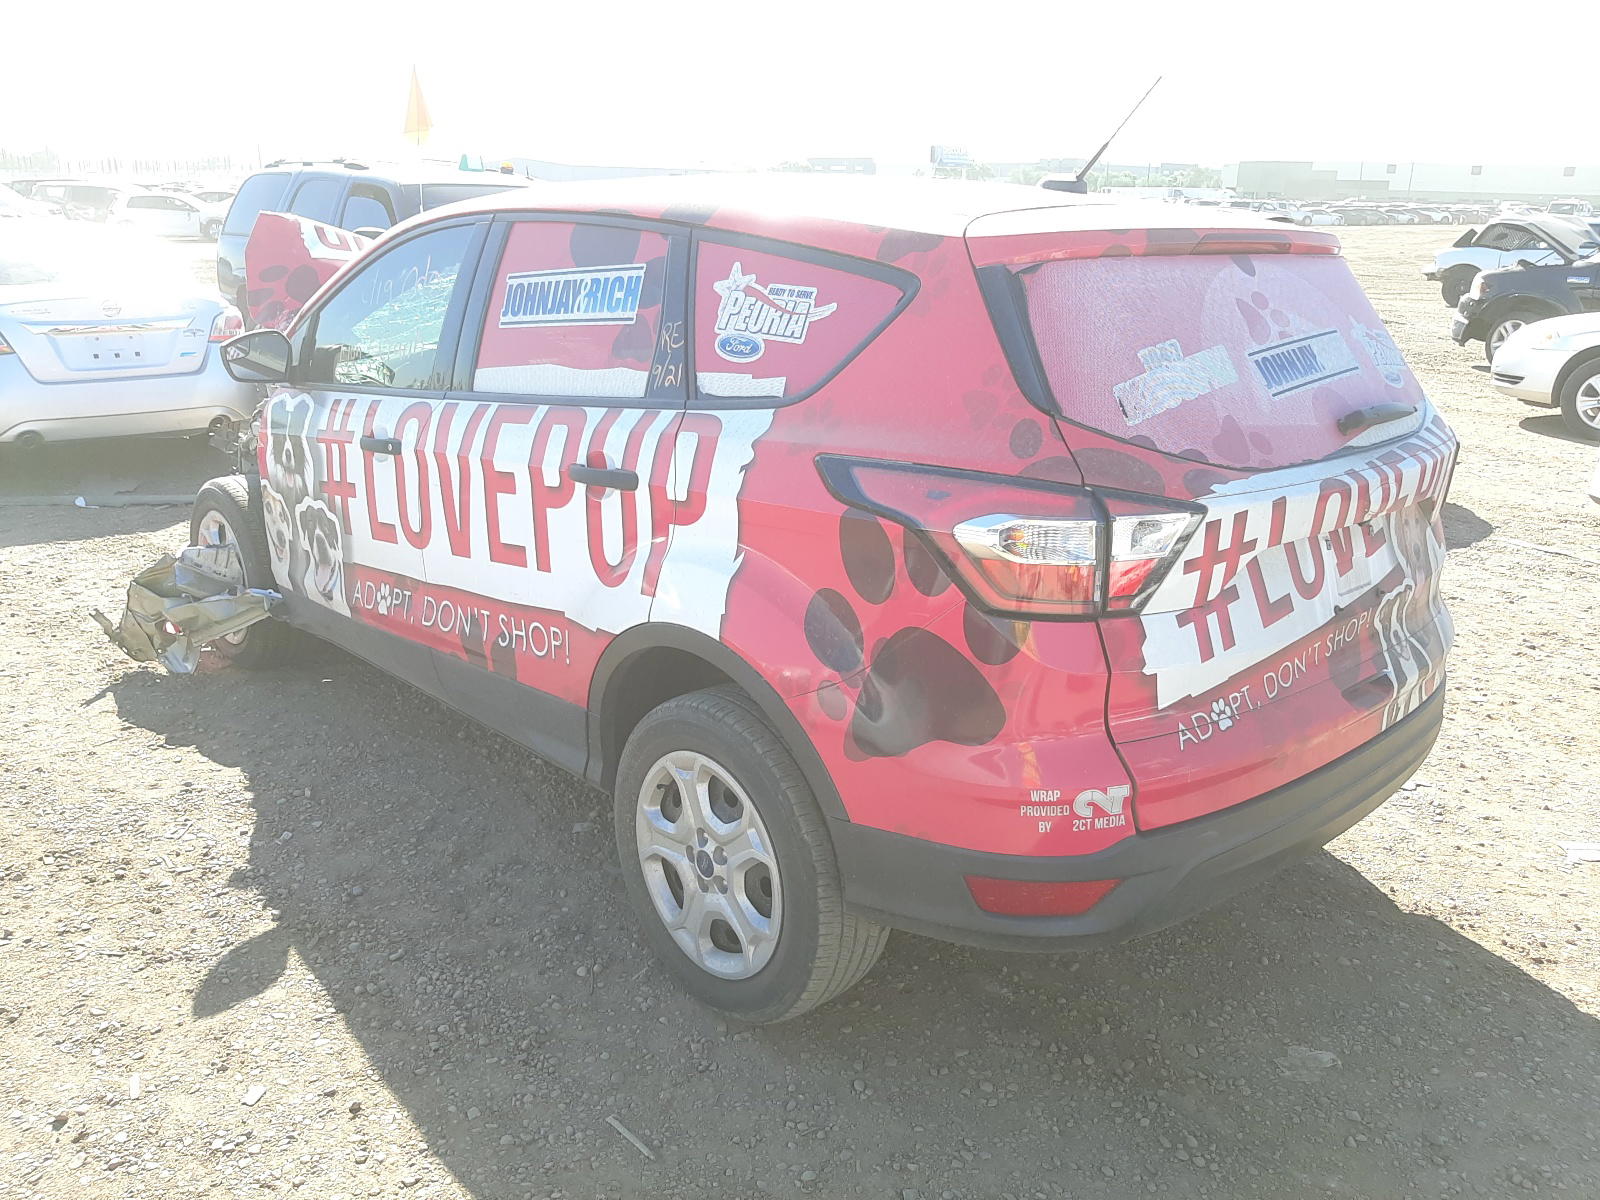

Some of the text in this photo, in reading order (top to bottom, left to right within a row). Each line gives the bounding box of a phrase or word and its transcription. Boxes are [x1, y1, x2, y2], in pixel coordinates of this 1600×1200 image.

[787, 289, 796, 298] TO
[795, 290, 814, 300] SERVE
[717, 290, 812, 340] PEORIA
[661, 320, 685, 352] RE
[725, 338, 753, 354] Ford
[652, 353, 683, 390] 9/21
[317, 398, 723, 598] #LOVEPUP
[352, 579, 570, 665] ADPT, DON'T SHOP!
[1178, 608, 1372, 751] ADPT, DON'T SHOP!
[1030, 790, 1061, 802] WRAP
[1020, 804, 1070, 817] PROVIDED
[1072, 814, 1126, 832] 2CT MEDIA
[1038, 821, 1052, 833] BY
